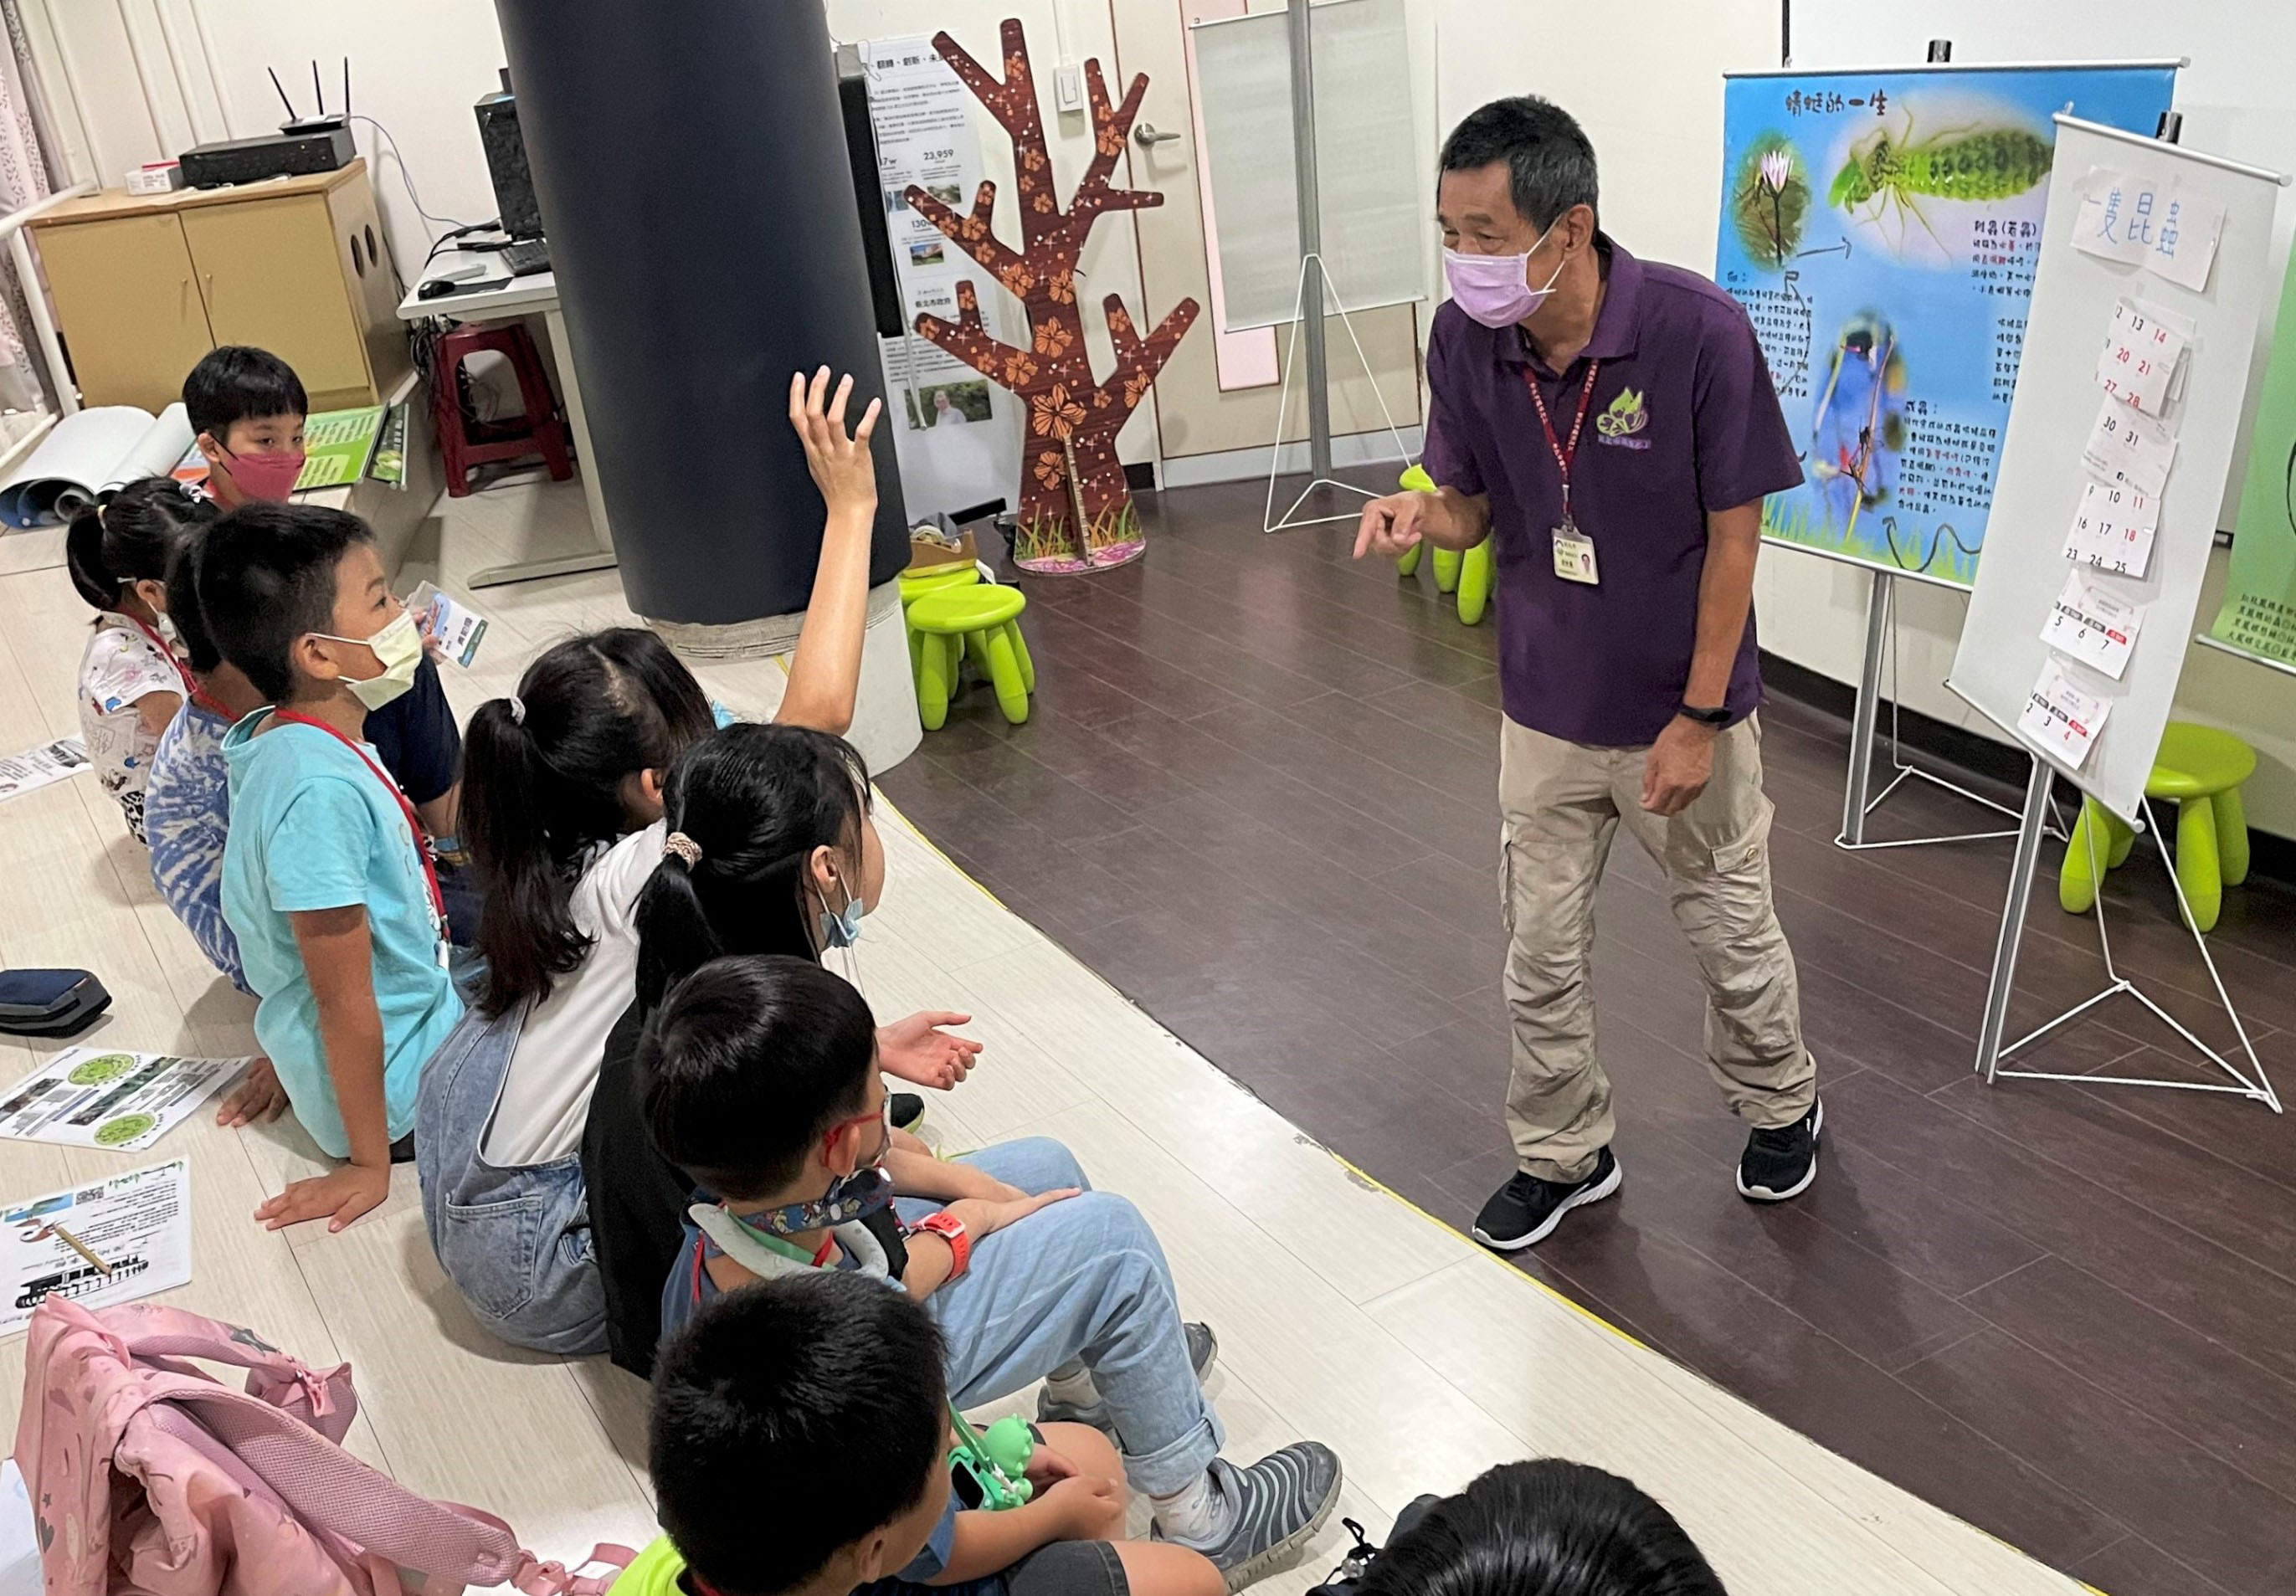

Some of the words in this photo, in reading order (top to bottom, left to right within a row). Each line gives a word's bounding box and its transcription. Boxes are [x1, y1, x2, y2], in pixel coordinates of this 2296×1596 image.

[1785, 89, 1888, 117] 蜻蜓的一生
[923, 149, 954, 161] 23,959
[2132, 316, 2144, 331] 13
[2154, 329, 2166, 343] 14
[2116, 347, 2129, 363] 20
[2139, 360, 2150, 375] 21
[2104, 379, 2117, 393] 27
[2126, 431, 2139, 446] 31
[2109, 490, 2121, 503] 10
[2134, 495, 2143, 509] 11
[2078, 516, 2088, 529] 16
[2099, 522, 2112, 535] 17
[2124, 528, 2136, 541] 18
[2066, 548, 2078, 561] 23
[2090, 554, 2102, 567] 24
[2114, 561, 2127, 573] 25
[2055, 616, 2063, 626] 5
[2078, 629, 2087, 639] 6
[2102, 640, 2109, 649] 7
[2026, 703, 2033, 713] 2
[2044, 716, 2052, 726] 3
[2064, 731, 2071, 741] 4
